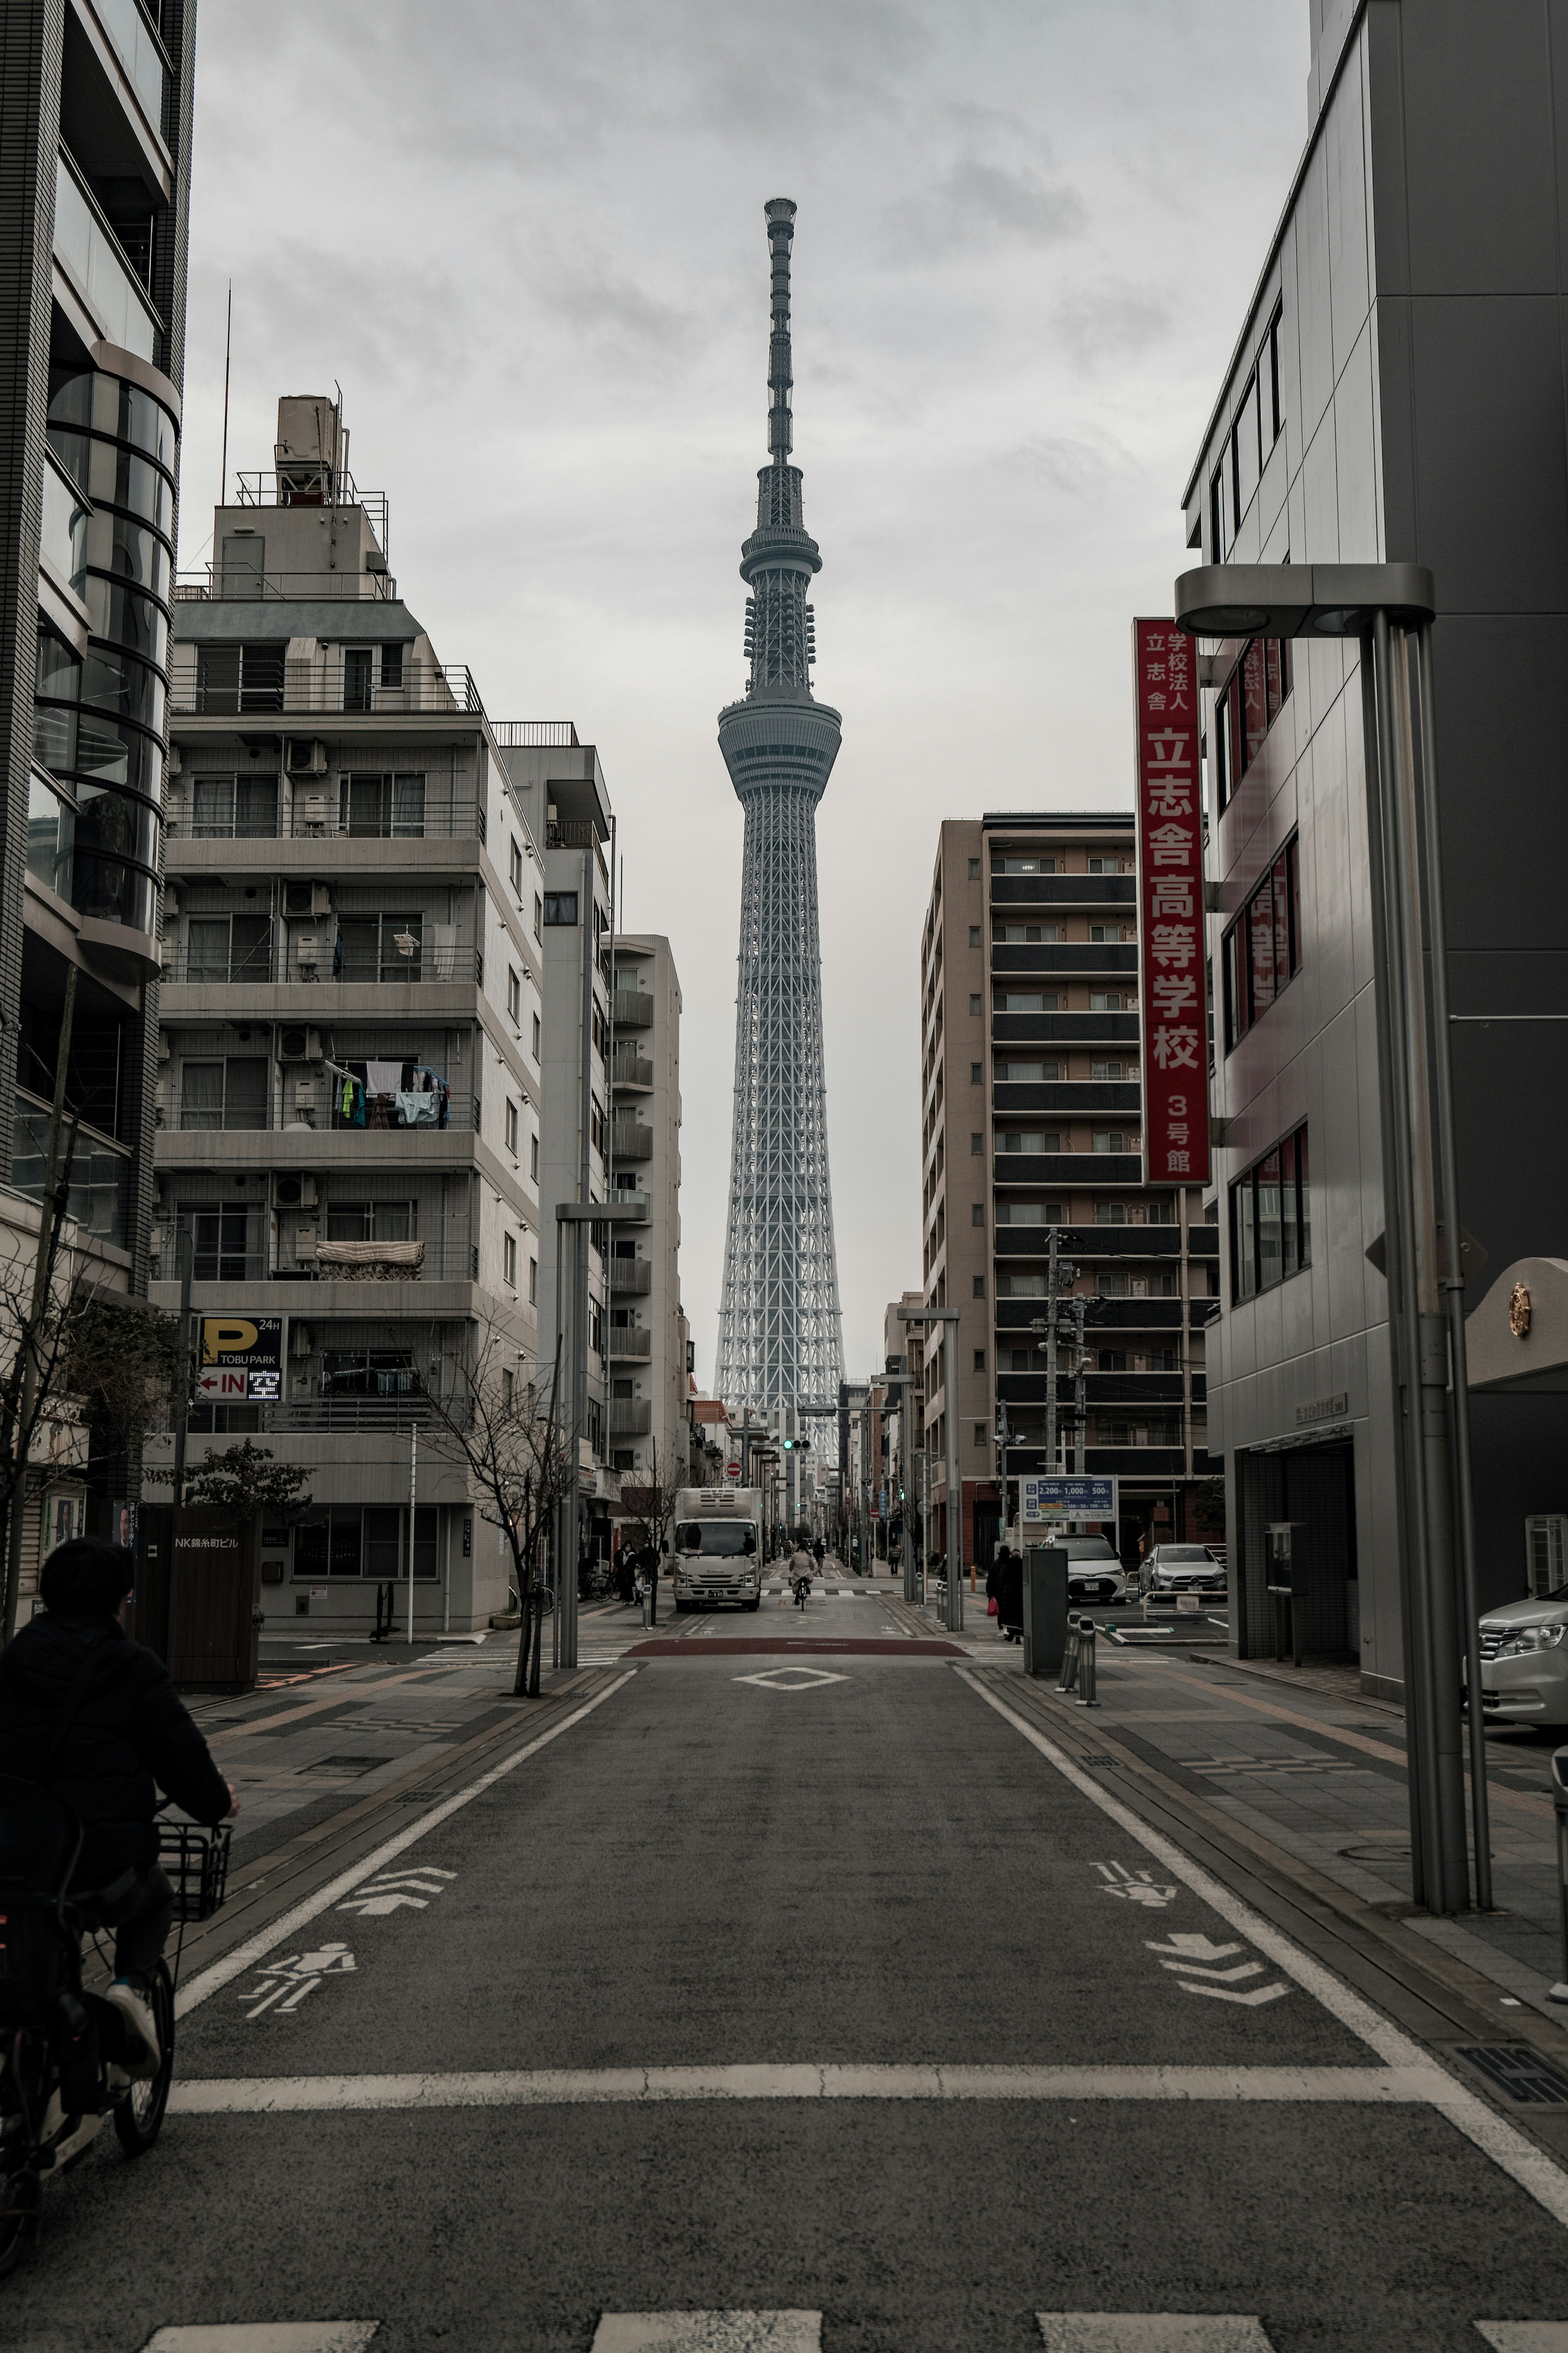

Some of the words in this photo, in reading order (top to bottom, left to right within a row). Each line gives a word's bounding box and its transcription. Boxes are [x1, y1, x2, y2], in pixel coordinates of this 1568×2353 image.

[1146, 633, 1167, 710] 立志舎
[1168, 633, 1189, 711] 学校法人
[1147, 727, 1199, 1070] 立志舎高等学校
[1167, 1095, 1190, 1173] 3号館
[203, 1318, 258, 1364] P
[258, 1319, 279, 1330] 24H
[220, 1355, 248, 1364] TOBU
[250, 1355, 276, 1364] PARK
[221, 1374, 245, 1393] IN
[248, 1371, 280, 1399] 空
[175, 1538, 238, 1548] NK錦糸町ビル
